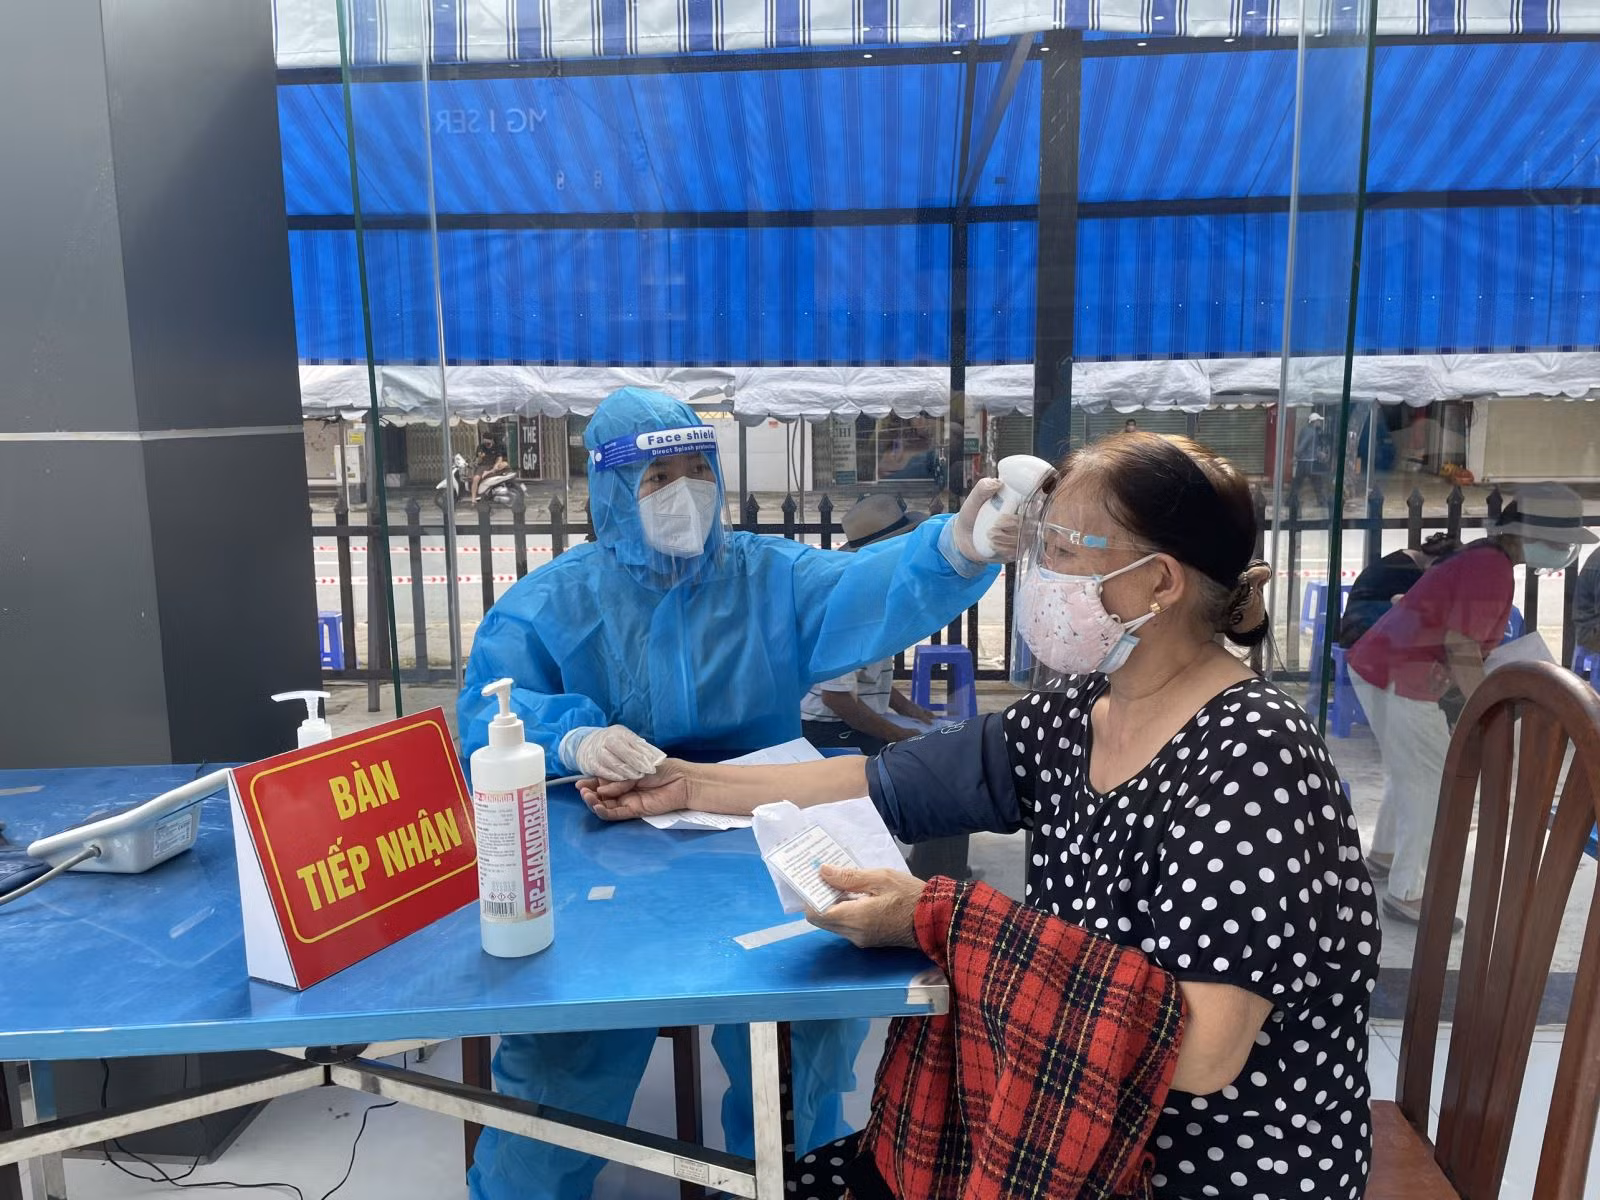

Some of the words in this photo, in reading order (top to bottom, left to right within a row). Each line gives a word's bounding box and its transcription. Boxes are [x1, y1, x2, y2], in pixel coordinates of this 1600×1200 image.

[647, 434, 682, 446] Face
[651, 447, 673, 456] Direct
[674, 444, 694, 454] Splash
[328, 760, 401, 821] BÀN
[296, 836, 370, 911] TIẾP
[375, 807, 463, 878] NHẬN
